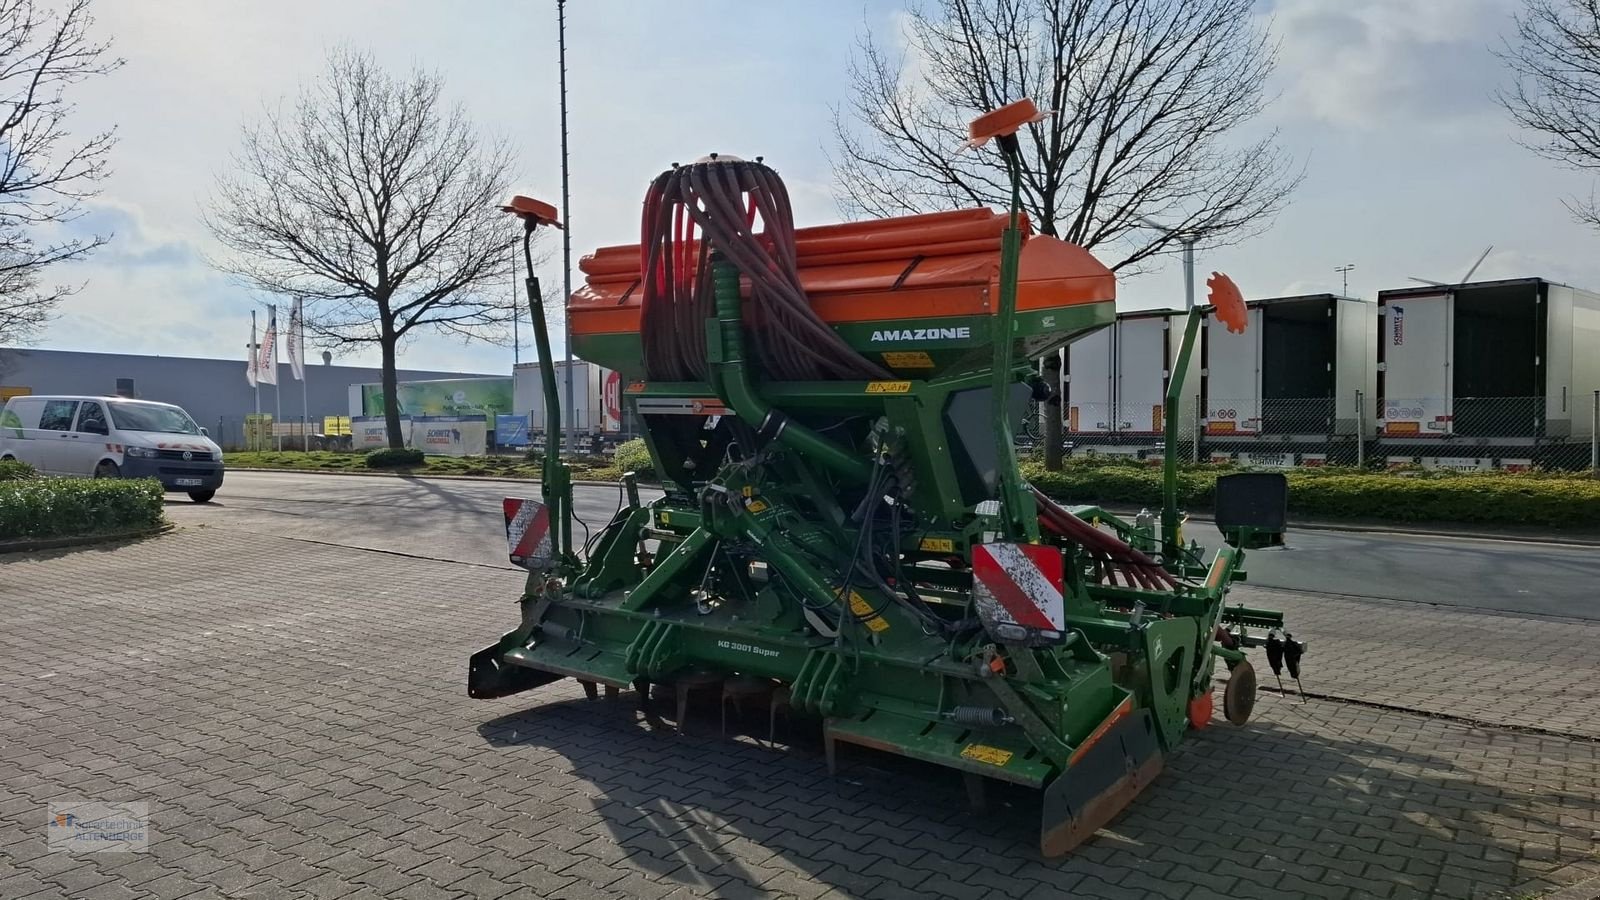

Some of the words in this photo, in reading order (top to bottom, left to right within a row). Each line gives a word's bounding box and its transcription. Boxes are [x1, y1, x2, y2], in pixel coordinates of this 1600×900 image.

[871, 327, 970, 342] AMAZONE
[717, 640, 730, 648] KG
[731, 642, 752, 652] 3001
[752, 646, 780, 657] Super
